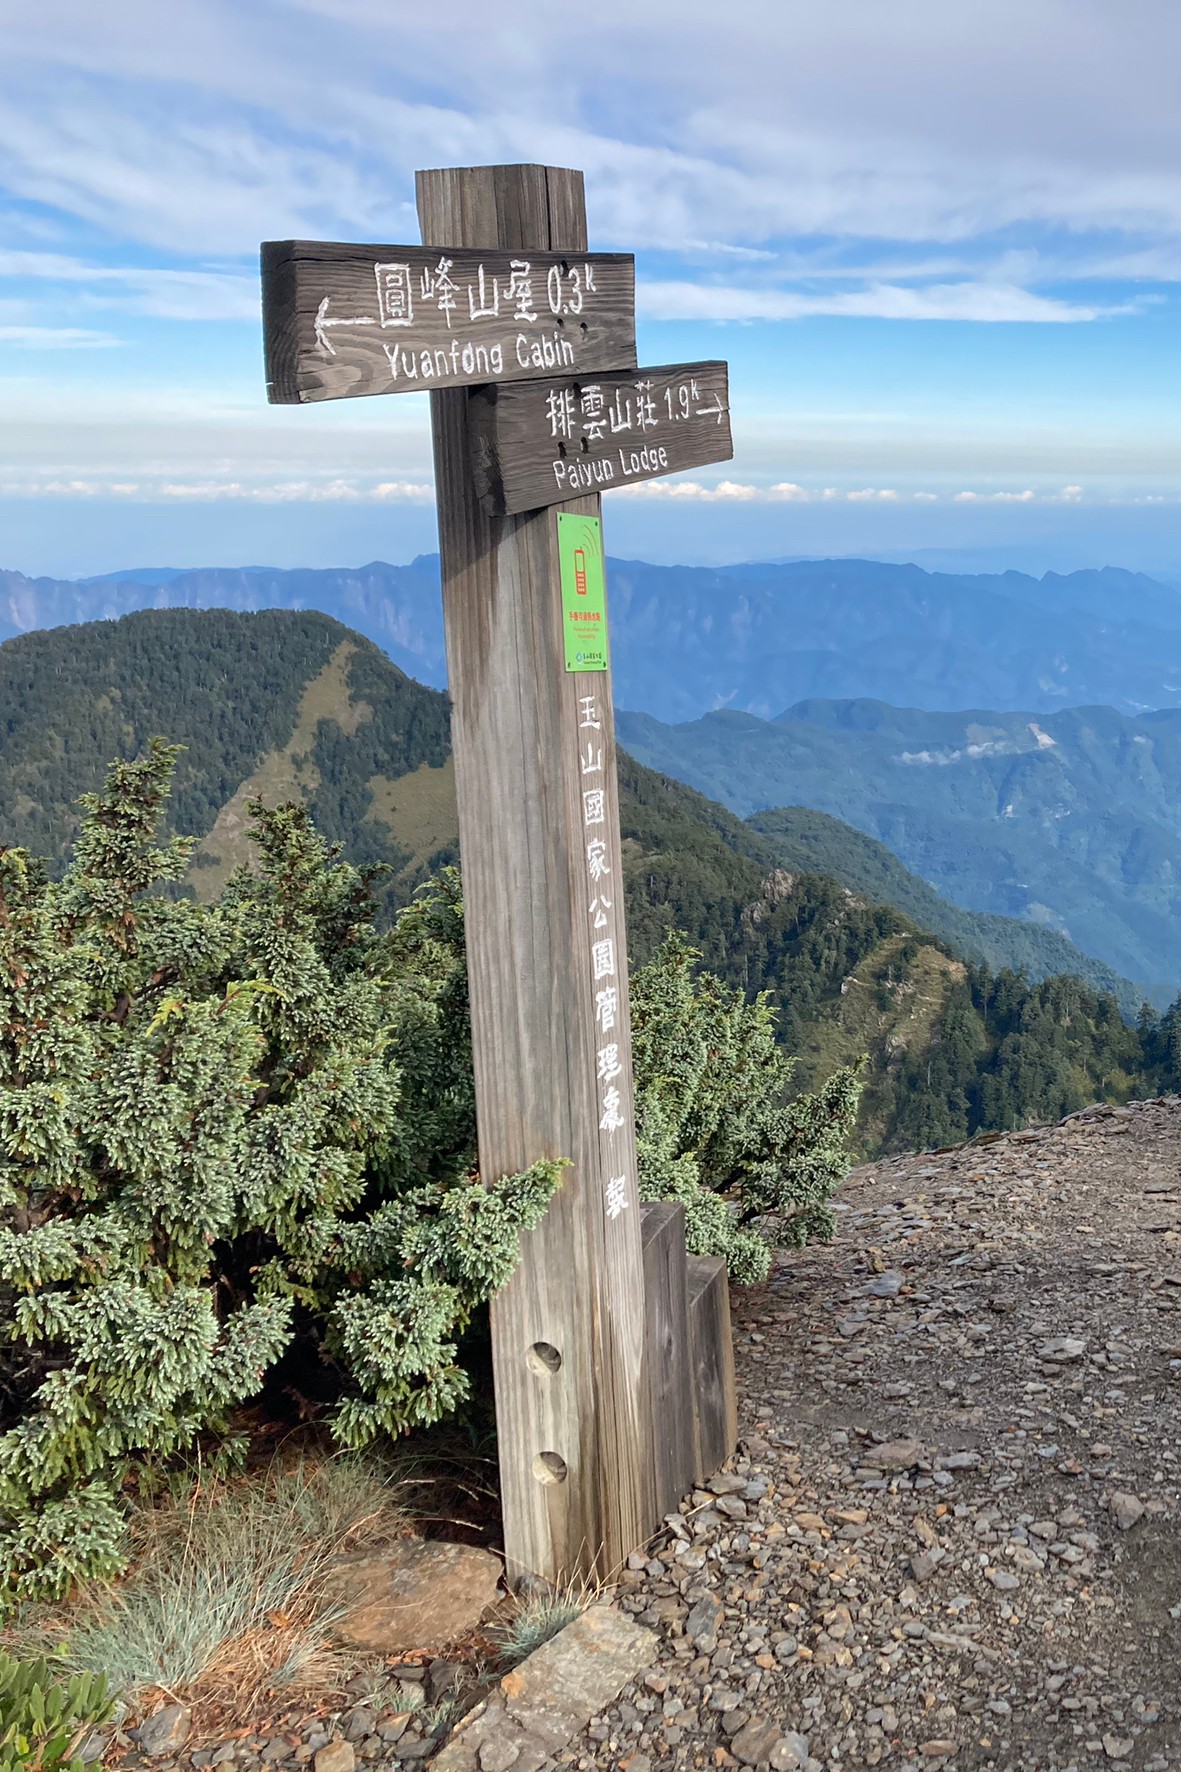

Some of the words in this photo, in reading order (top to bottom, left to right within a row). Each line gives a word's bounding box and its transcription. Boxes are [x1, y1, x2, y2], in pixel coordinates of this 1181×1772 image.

[375, 256, 537, 328] 圓峰山屋
[516, 330, 576, 370] Cabin
[545, 379, 659, 440] 排雲山莊
[553, 457, 614, 491] Paiyun
[618, 445, 668, 476] Lodge
